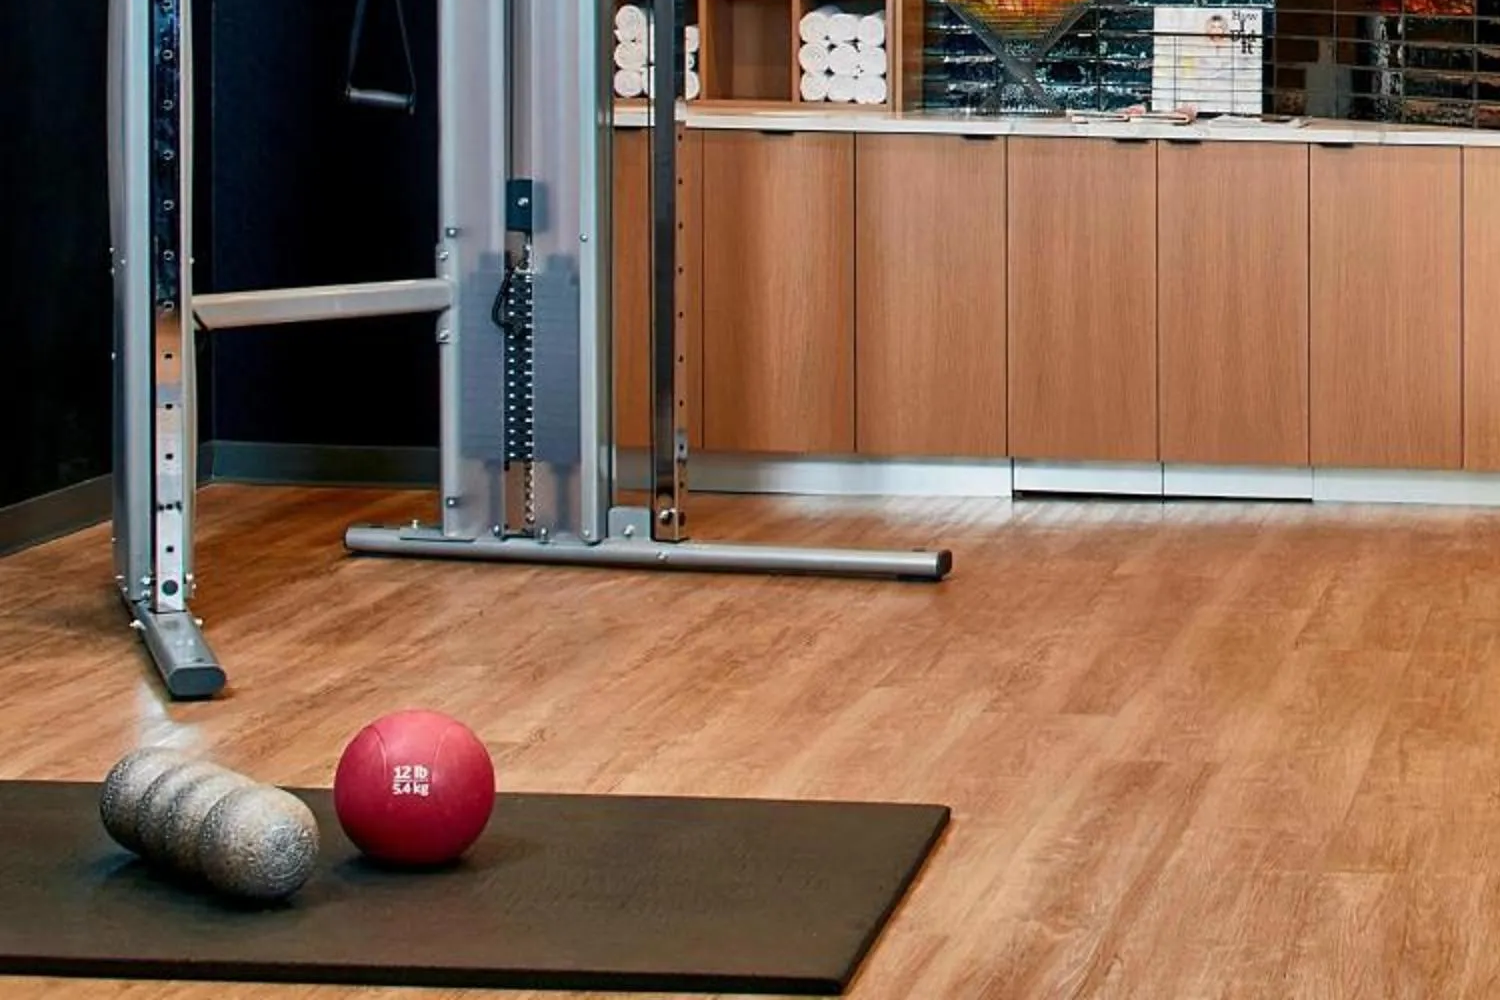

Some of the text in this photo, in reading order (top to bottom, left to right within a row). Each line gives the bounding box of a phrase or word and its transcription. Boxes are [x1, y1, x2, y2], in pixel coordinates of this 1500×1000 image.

[393, 764, 429, 779] 12 lb
[413, 781, 430, 797] kg
